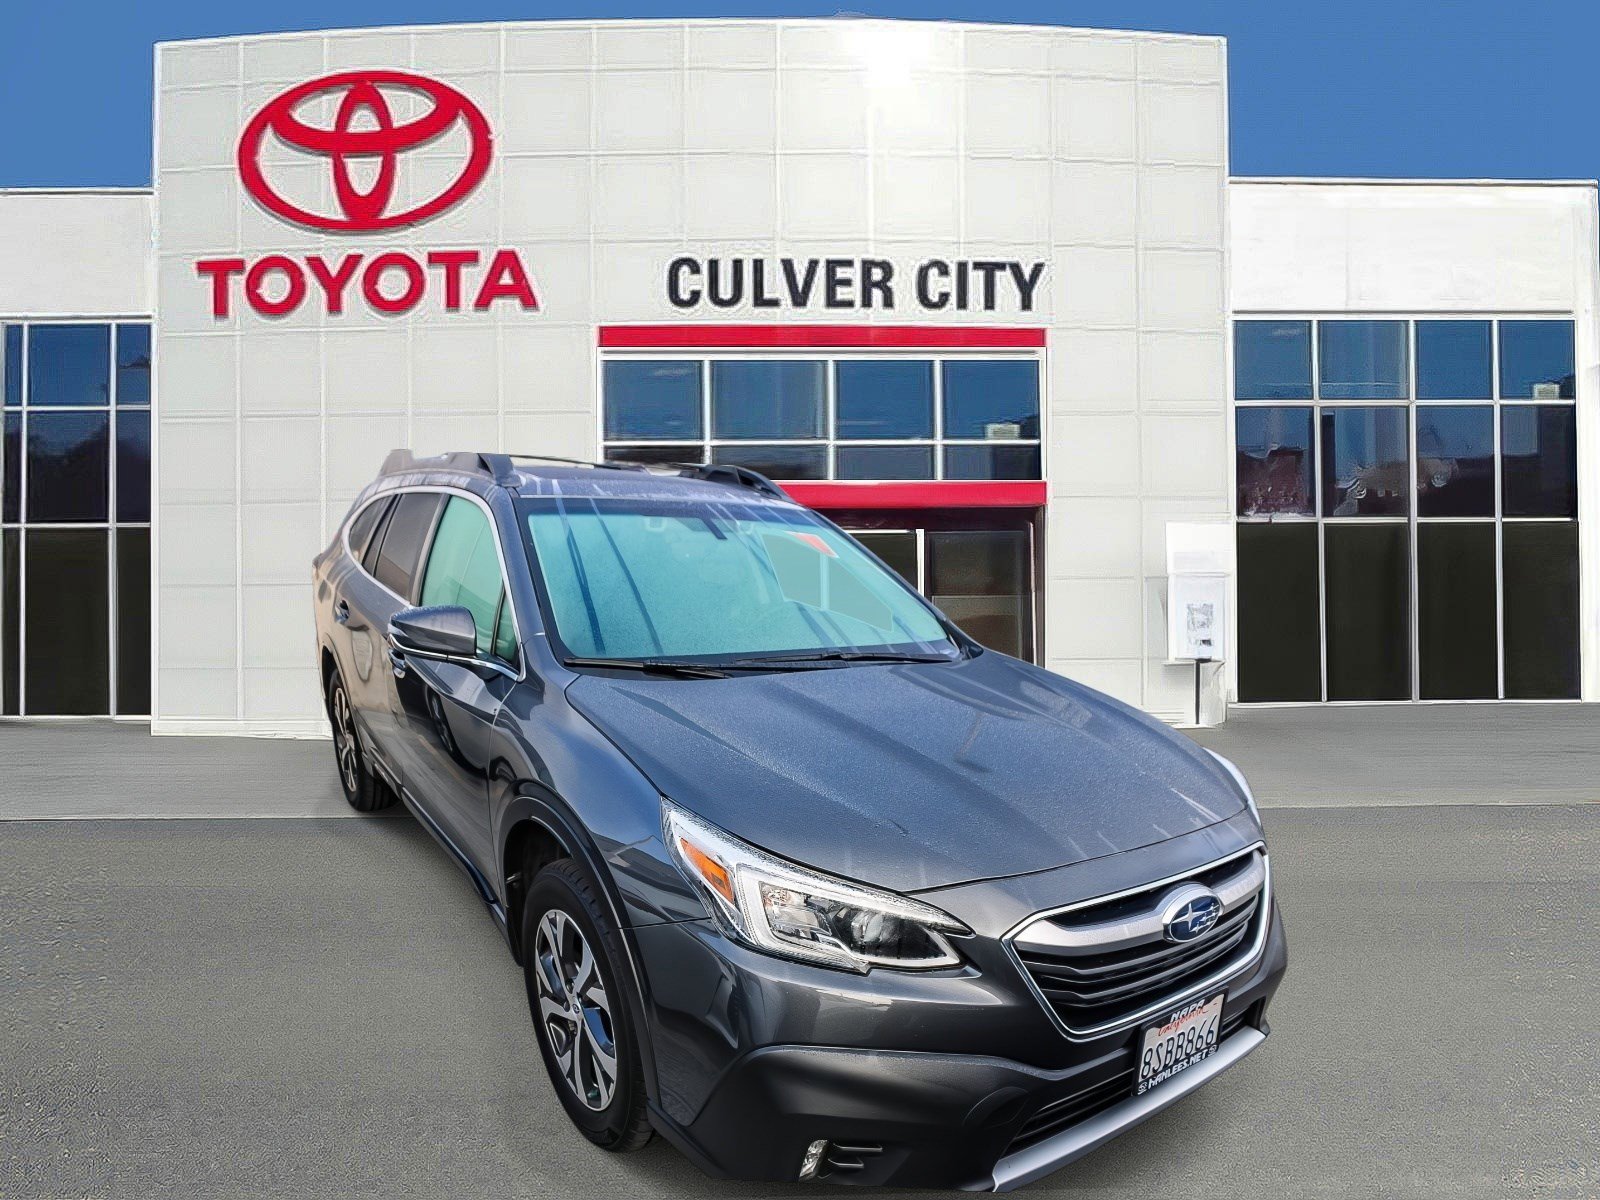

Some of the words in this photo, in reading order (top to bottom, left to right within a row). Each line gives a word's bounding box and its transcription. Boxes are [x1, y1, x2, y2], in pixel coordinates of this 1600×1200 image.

[197, 249, 540, 318] TOYOTA
[667, 257, 894, 309] CULVER
[915, 259, 1045, 311] CITY
[1170, 998, 1206, 1023] NAPA
[1140, 1014, 1218, 1079] 8SBB866
